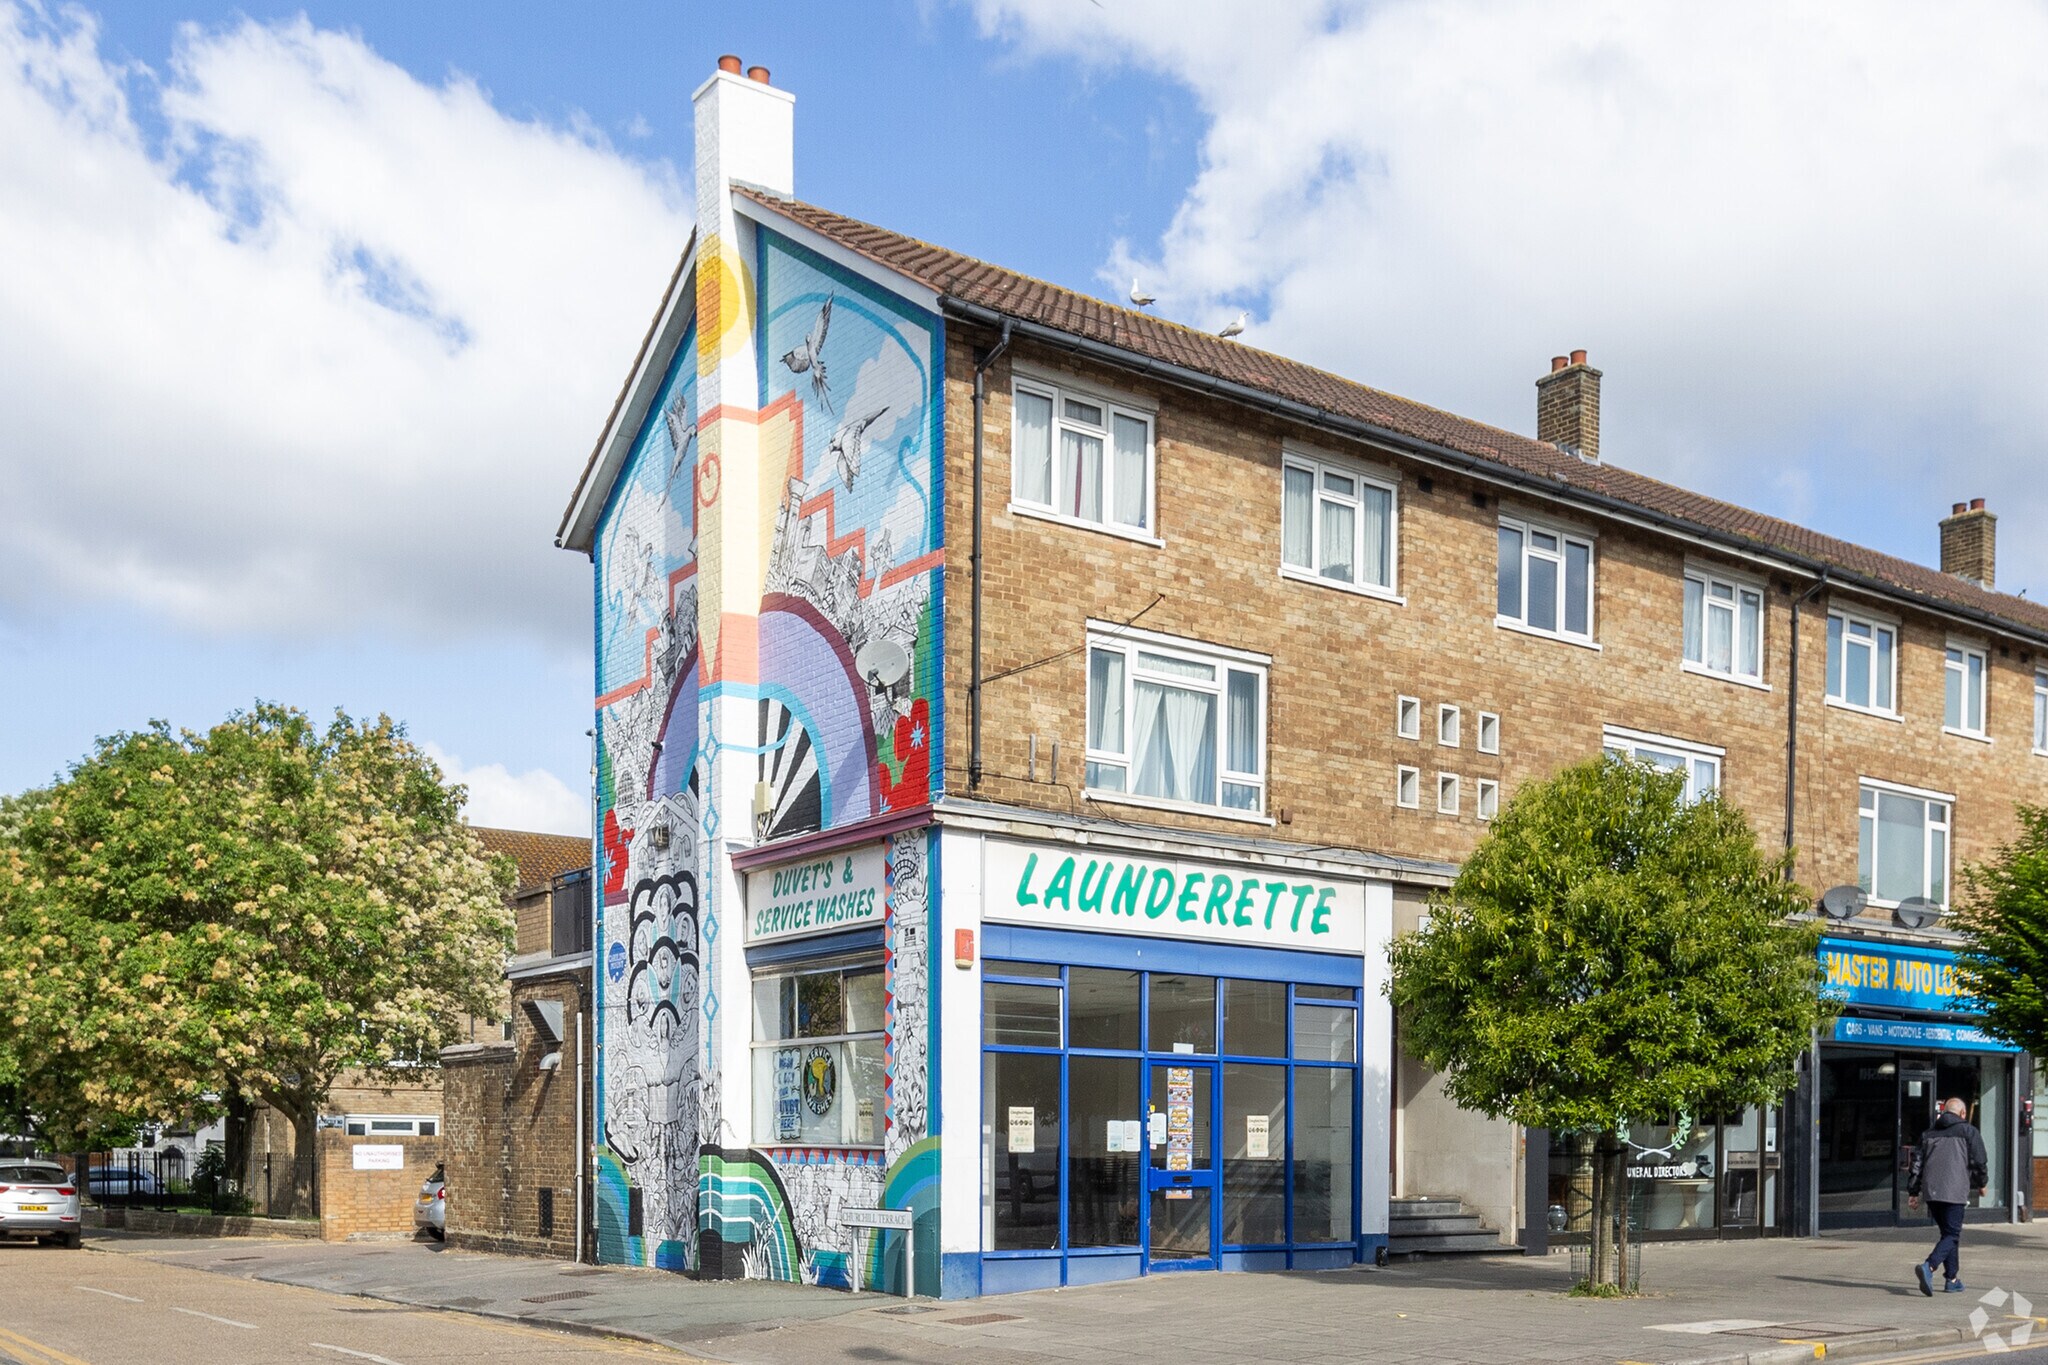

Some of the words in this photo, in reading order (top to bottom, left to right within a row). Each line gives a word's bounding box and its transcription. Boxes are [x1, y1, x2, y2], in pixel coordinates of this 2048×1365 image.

[772, 860, 834, 899] DUVET'S
[842, 856, 854, 885] &
[1016, 852, 1337, 935] LAUNDERETTE
[754, 900, 814, 936] SERVICE
[815, 887, 876, 925] WASHES
[1827, 952, 1889, 990] MASTER
[1893, 960, 1933, 994] AUTO
[1846, 1022, 1863, 1036] CARS
[1868, 1023, 1884, 1037] VANS
[807, 1046, 833, 1067] SERVICE
[806, 1094, 833, 1115] WASHES
[1626, 1166, 1652, 1179] UNERAL
[878, 1213, 906, 1226] TERRACE
